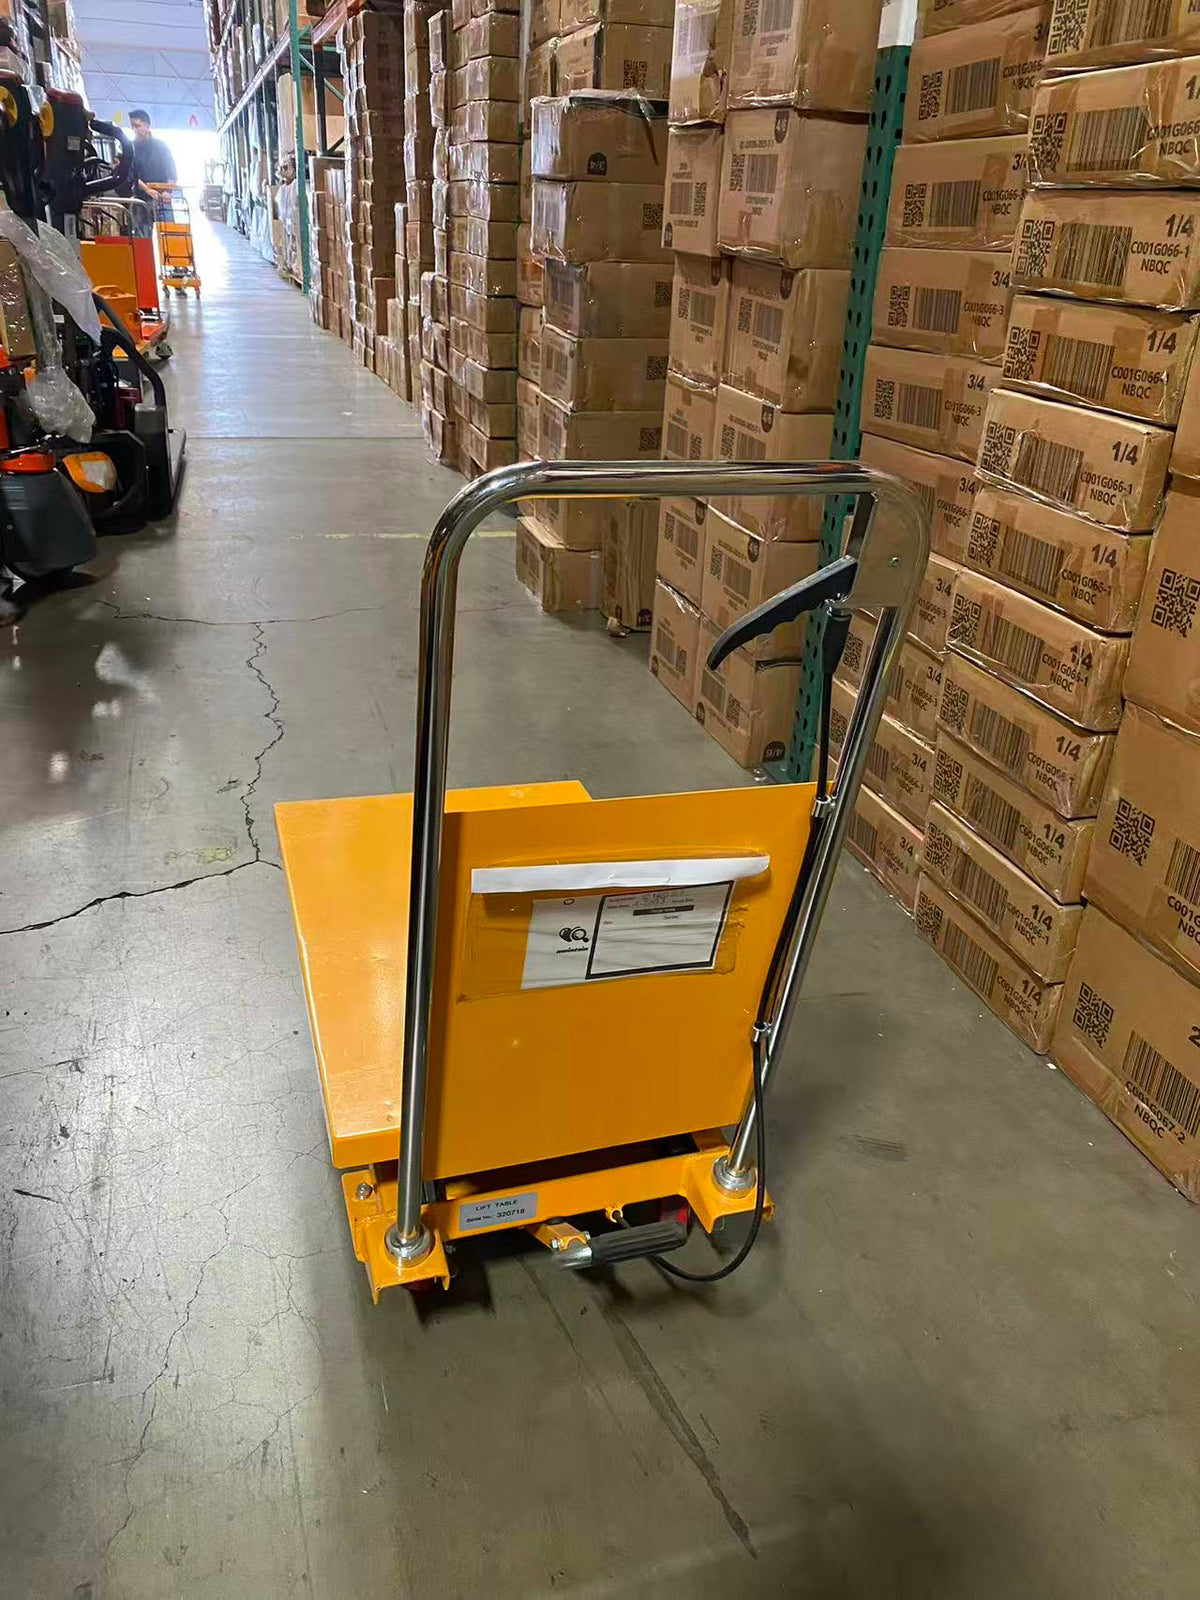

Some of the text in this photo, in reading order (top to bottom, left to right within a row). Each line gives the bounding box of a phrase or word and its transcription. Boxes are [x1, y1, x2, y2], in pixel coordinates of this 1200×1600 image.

[1185, 74, 1200, 100] 1/
[1147, 120, 1200, 141] C001G066
[1159, 139, 1192, 157] NBQC
[1165, 213, 1194, 238] 1/4
[1130, 241, 1190, 259] C001G066-1
[991, 270, 1011, 288] 3/4
[1140, 258, 1171, 276] NBQC
[1147, 330, 1177, 355] 1/4
[967, 374, 986, 391] 3/4
[1121, 383, 1152, 399] NBQC
[1111, 440, 1138, 466] 1/4
[959, 477, 976, 496] 3/4
[1080, 471, 1133, 495] C001G066-1
[1089, 487, 1117, 506] NBQC
[1092, 543, 1117, 568] 1/4
[935, 577, 952, 597] 3/4
[1061, 568, 1112, 597] C001G066-1
[1070, 585, 1097, 606] NBQC
[1042, 653, 1089, 687] C001G066-1
[1070, 645, 1093, 671] 1/4
[926, 666, 942, 685] 3/4
[1049, 670, 1075, 693] NBQC
[1056, 736, 1081, 761] 1/4
[911, 752, 927, 773] 3/4
[899, 836, 914, 857] 3/4
[1019, 824, 1063, 865] C001G066-1
[1043, 823, 1066, 850] 1/4
[1026, 842, 1050, 866] NBQC
[1005, 902, 1050, 945] C001G066-1
[1032, 904, 1053, 931] 1/4
[1167, 895, 1200, 929] C001G
[1014, 920, 1036, 946] NBQC
[996, 975, 1039, 1020] C001G066-1
[1022, 979, 1042, 1006] 1/4
[1004, 993, 1026, 1020] NBQC
[1125, 1080, 1186, 1145] C001G067-2
[1134, 1103, 1166, 1139] NBQC
[495, 1199, 518, 1207] TABLE
